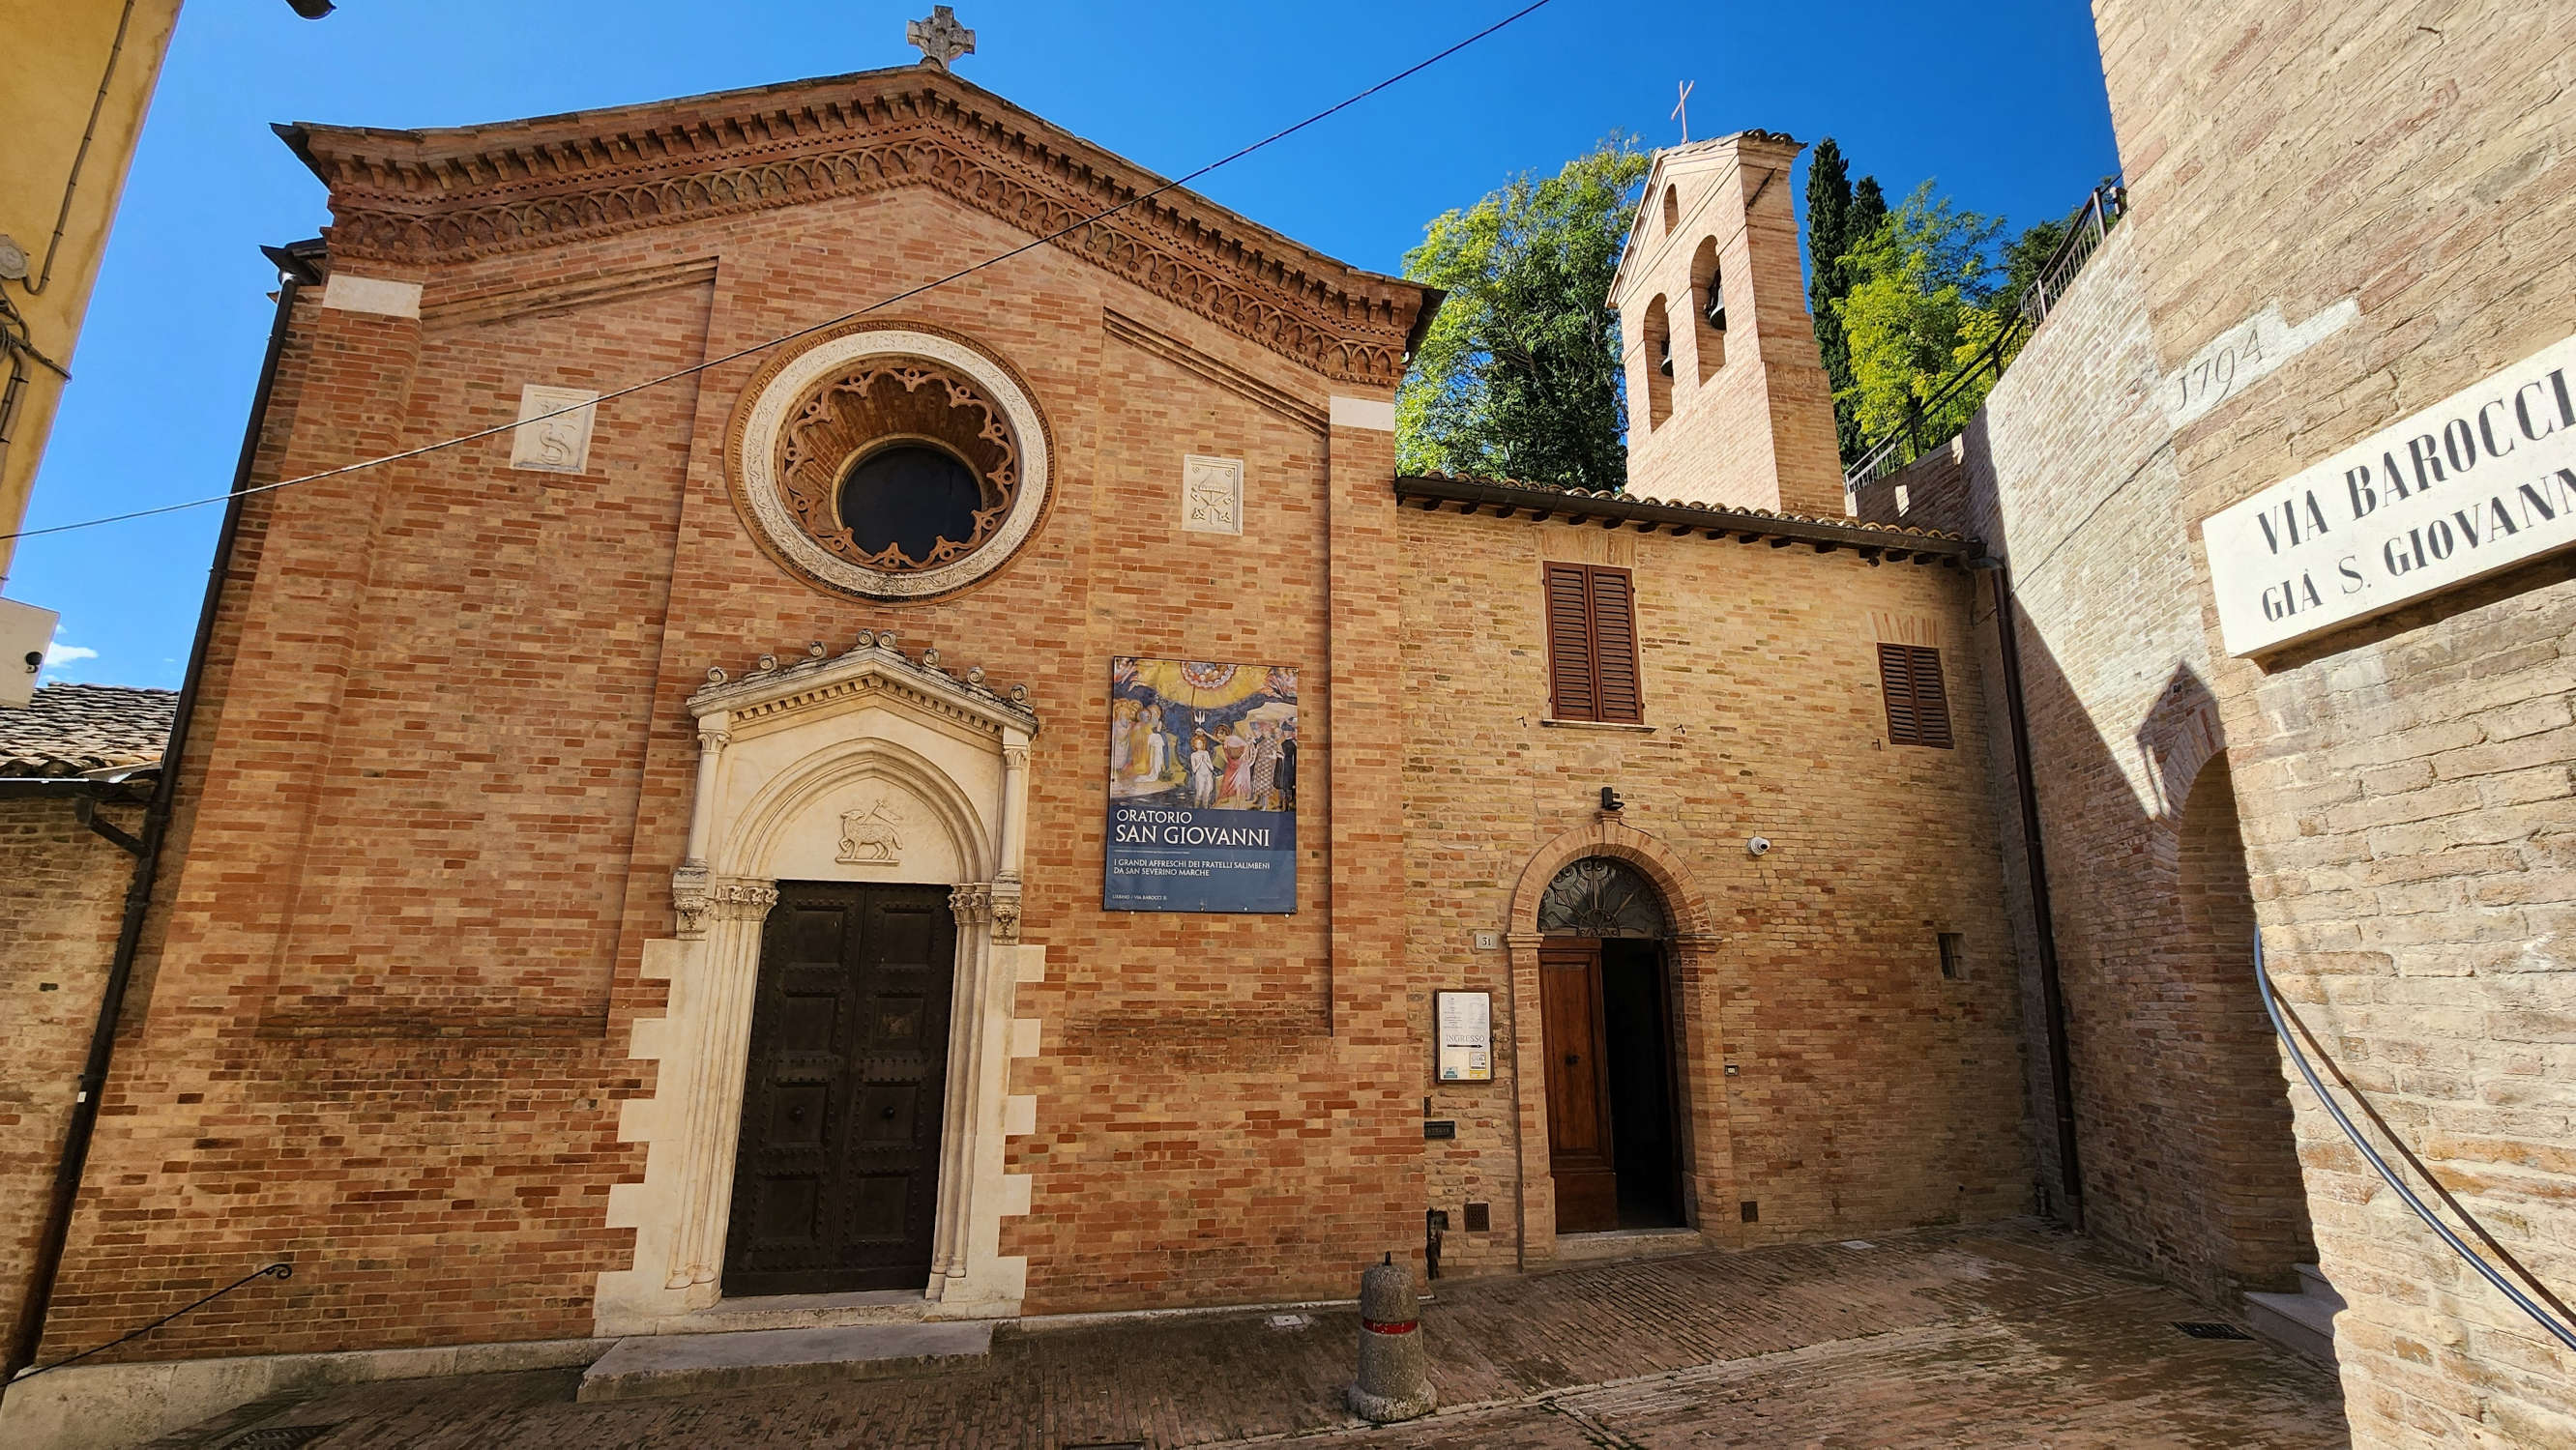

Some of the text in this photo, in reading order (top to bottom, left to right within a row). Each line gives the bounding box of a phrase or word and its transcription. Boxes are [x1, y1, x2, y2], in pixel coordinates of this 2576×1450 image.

[2175, 328, 2265, 412] 1794
[2257, 367, 2576, 555] VIA BAROCCI
[2338, 555, 2372, 594] S.
[1116, 809, 1192, 824] ORATORIO
[1115, 825, 1270, 847] SAN GIOVANNI
[1118, 858, 1148, 867] GRANDI
[1148, 859, 1186, 868] AFFRESCHI
[1201, 860, 1233, 869] FRATELLI
[1233, 861, 1271, 870] SALIMBENI
[1141, 867, 1178, 876] SEVERINO
[1481, 936, 1491, 946] 31
[1446, 1034, 1485, 1043] INGRESSO
